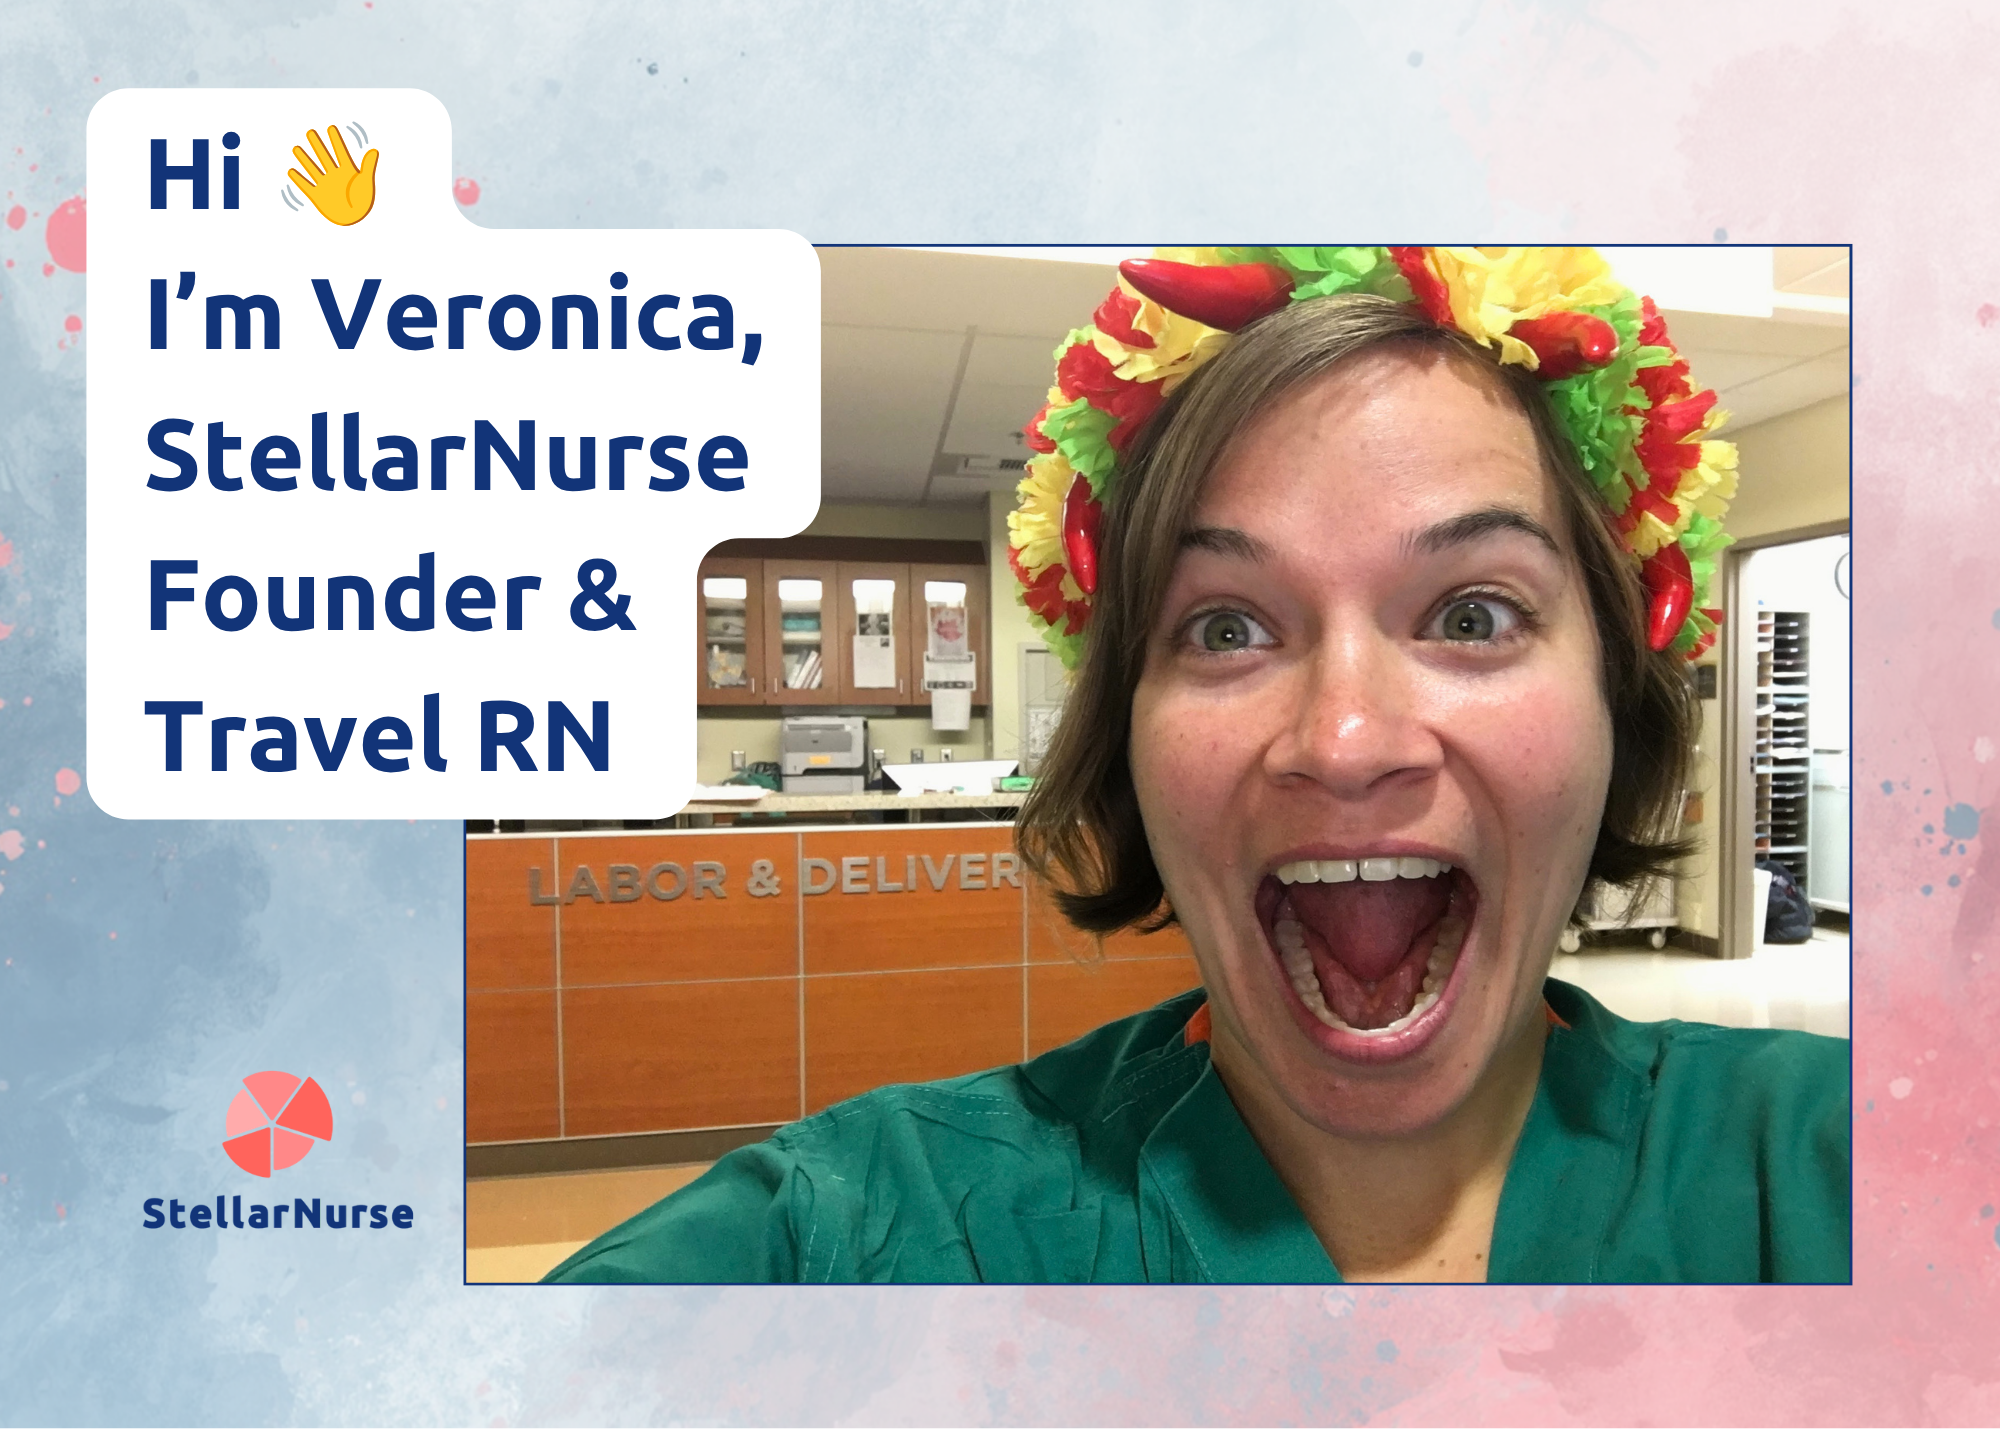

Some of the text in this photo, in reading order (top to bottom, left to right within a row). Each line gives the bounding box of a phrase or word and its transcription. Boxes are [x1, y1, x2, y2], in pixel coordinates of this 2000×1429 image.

[529, 852, 1042, 906] LABOR & DELIVER
